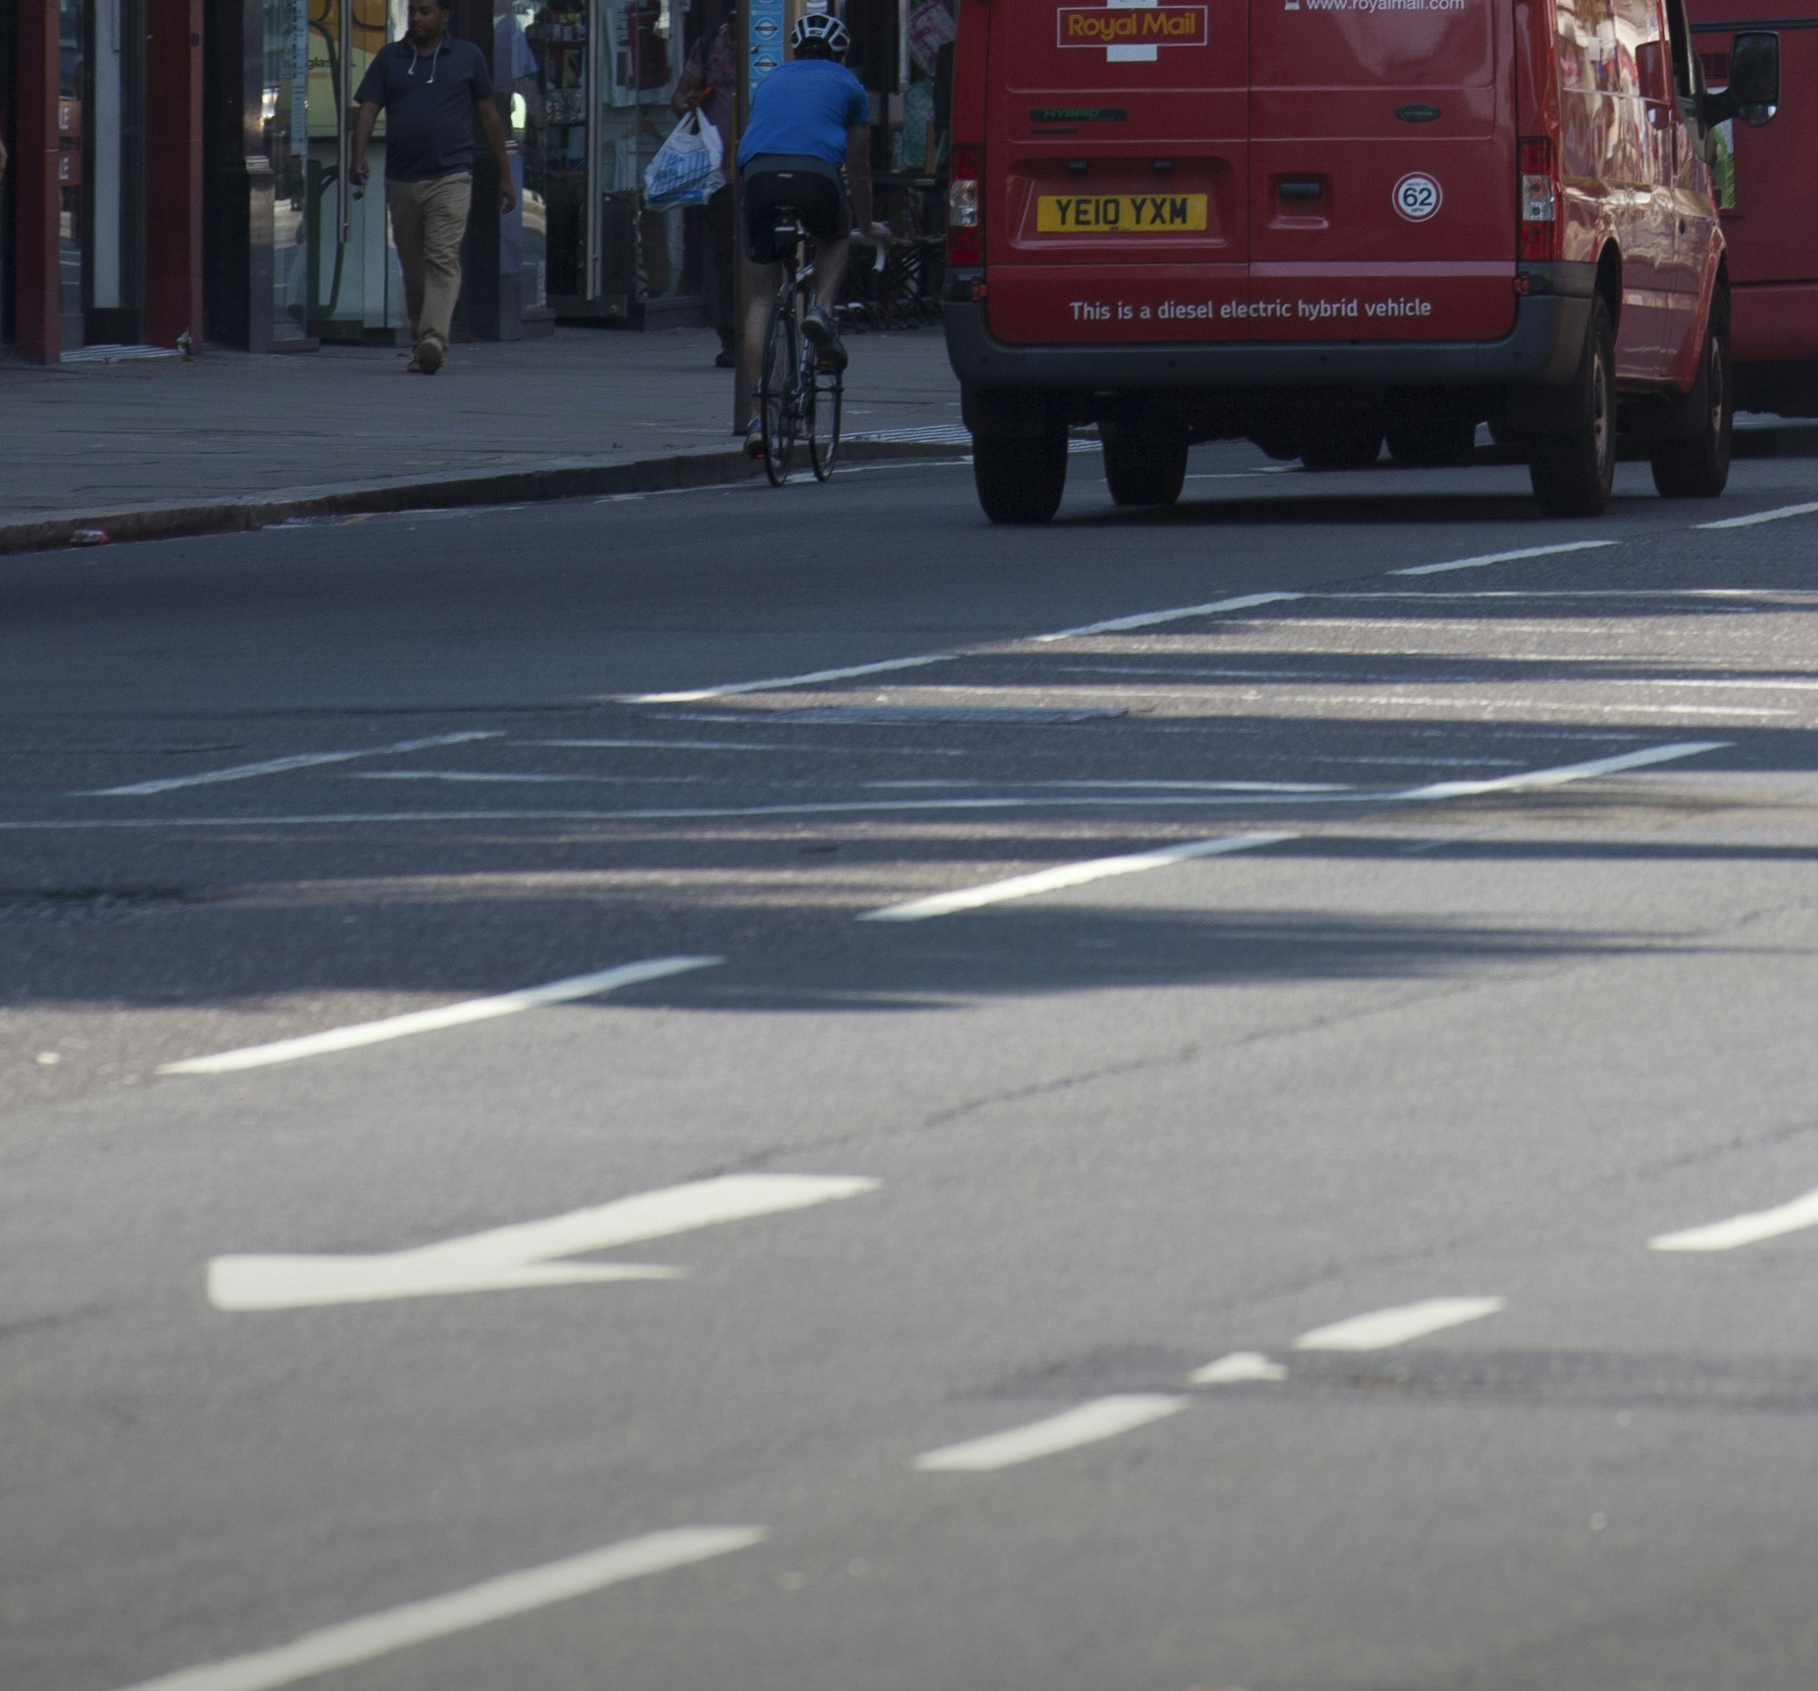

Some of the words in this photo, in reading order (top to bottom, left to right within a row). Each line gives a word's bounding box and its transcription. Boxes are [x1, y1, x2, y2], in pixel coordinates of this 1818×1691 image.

[1068, 14, 1137, 41] Royal
[1142, 12, 1196, 35] Mail
[1043, 108, 1101, 118] HYBRID
[1403, 187, 1432, 207] 62
[1056, 198, 1120, 225] YE10
[1131, 197, 1188, 225] YXM
[1070, 301, 1110, 320] This
[1117, 300, 1133, 319] is
[1139, 305, 1151, 319] a
[1157, 300, 1213, 319] diesel
[1220, 299, 1292, 318] electric
[1297, 299, 1358, 321] hybrid
[1364, 297, 1431, 317] vehicle
